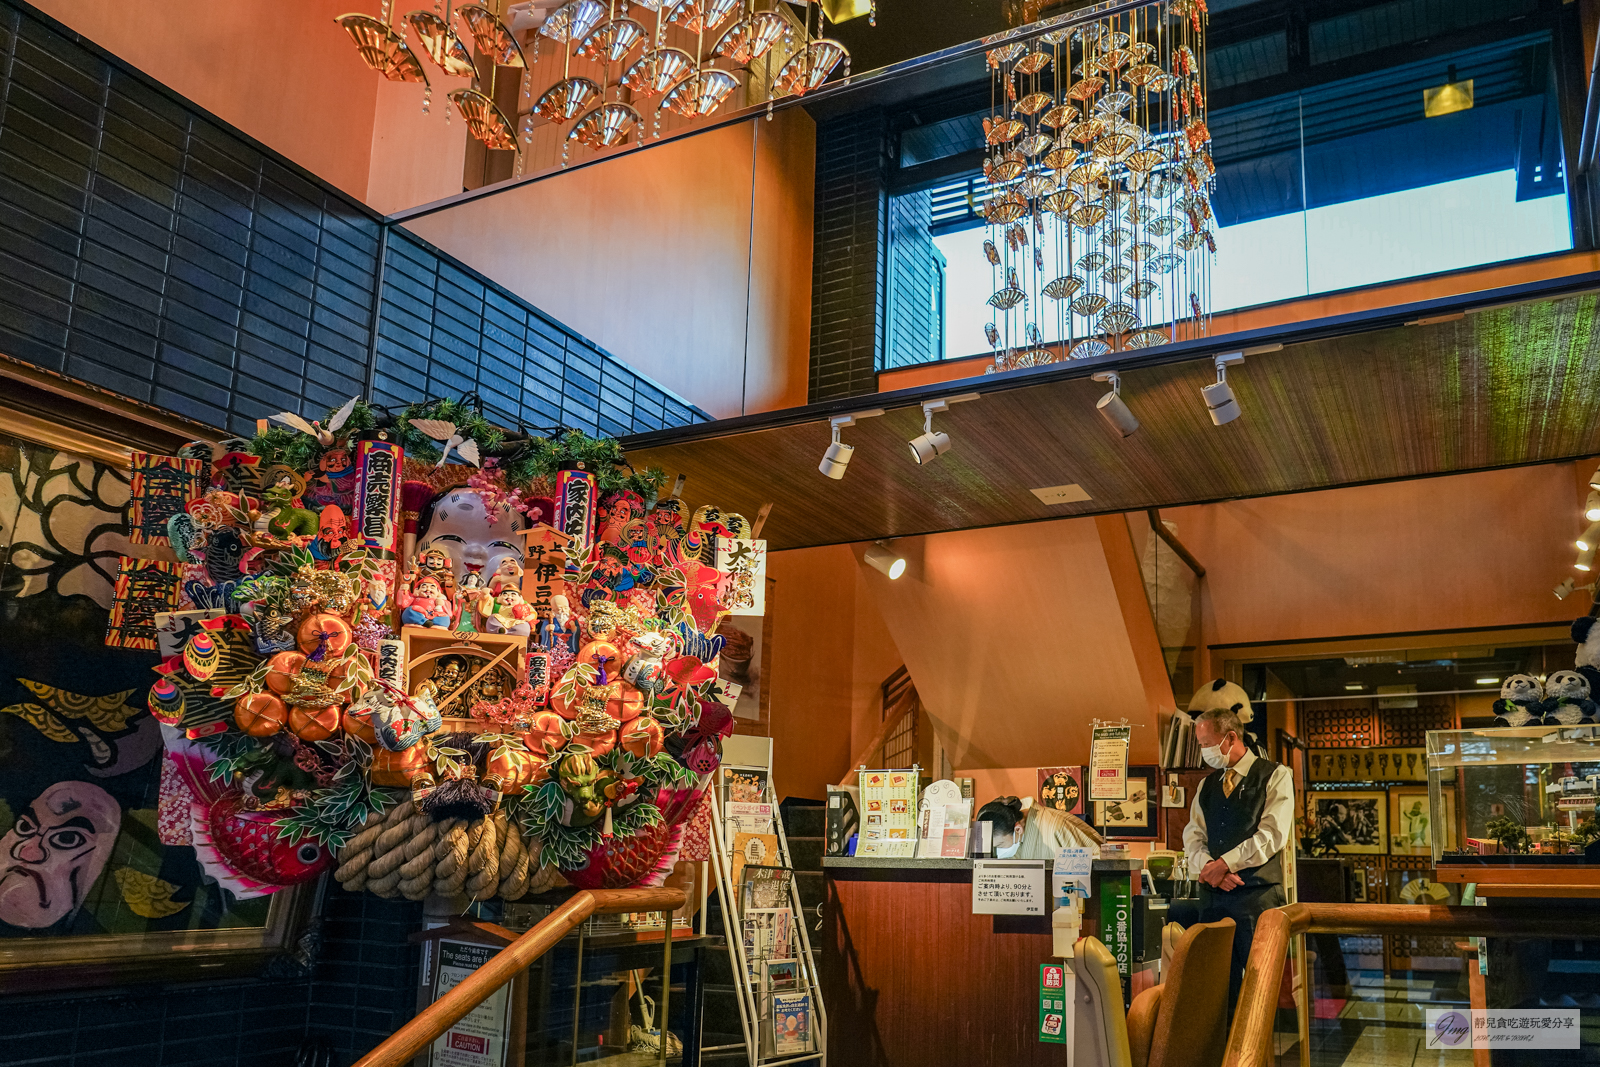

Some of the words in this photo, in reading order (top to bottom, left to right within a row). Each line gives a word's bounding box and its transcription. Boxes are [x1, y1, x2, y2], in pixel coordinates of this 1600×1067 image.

[442, 950, 454, 960] The
[454, 953, 470, 962] seats
[455, 1041, 480, 1051] CAUTION
